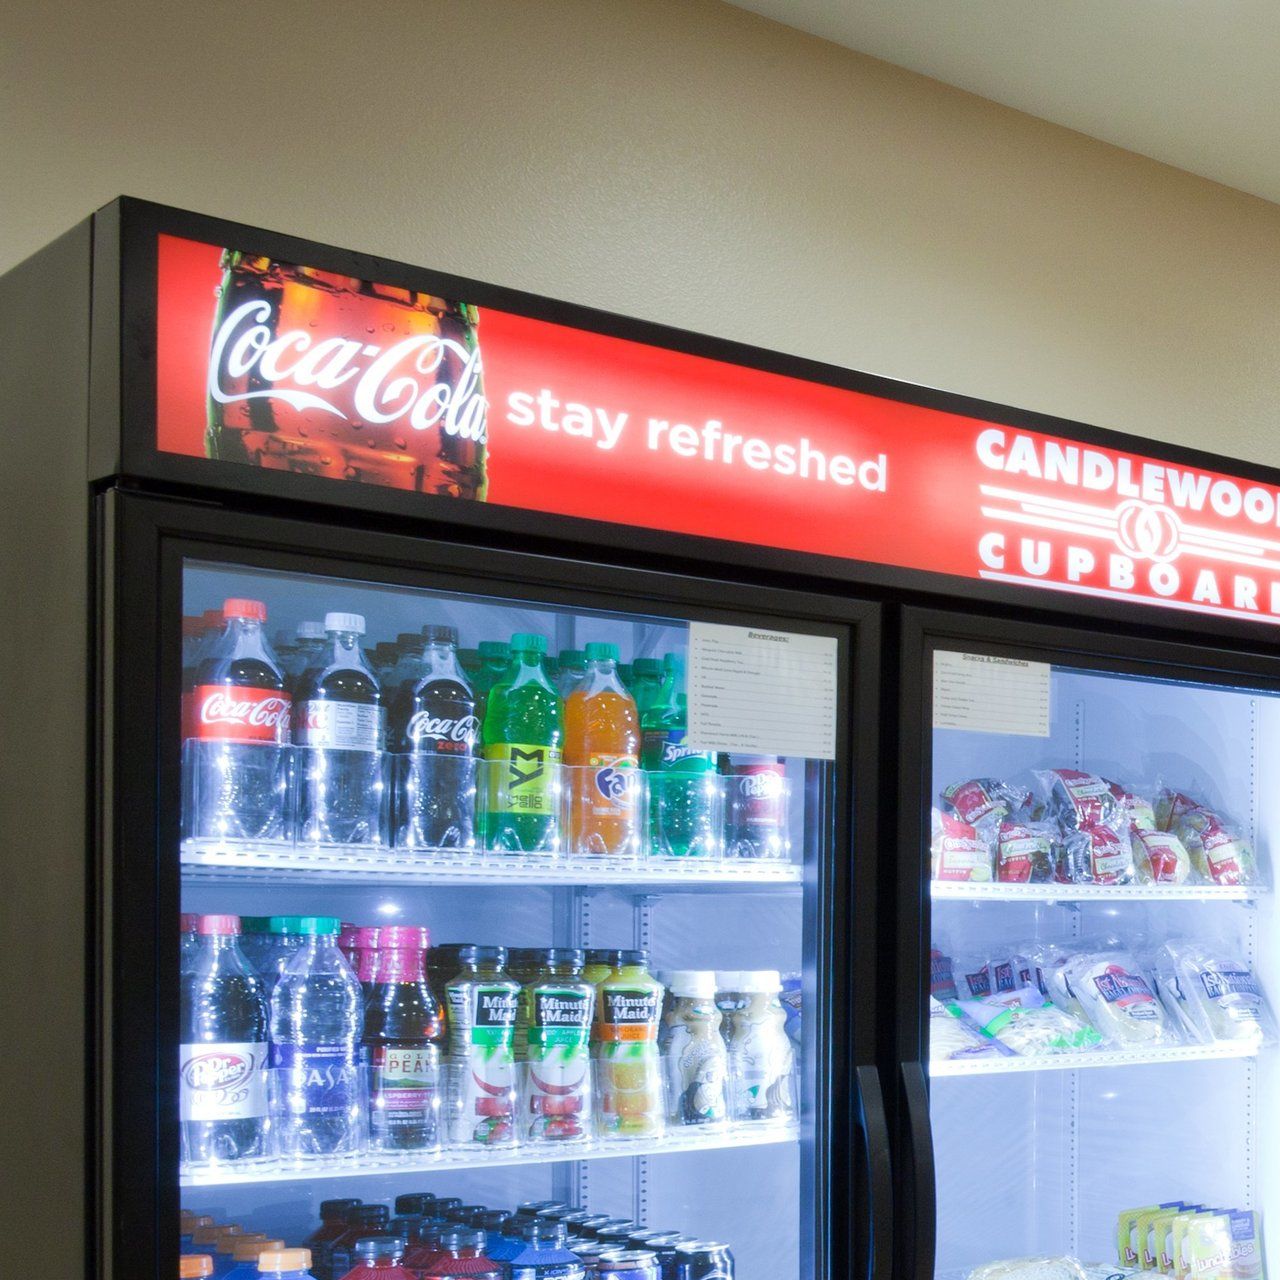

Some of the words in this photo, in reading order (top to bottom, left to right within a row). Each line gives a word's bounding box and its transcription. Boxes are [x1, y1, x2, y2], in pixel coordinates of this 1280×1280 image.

[207, 299, 488, 445] Coca-Cola
[507, 388, 628, 450] stay
[646, 418, 888, 493] refreshed
[545, 1009, 584, 1023] Maid
[614, 1007, 650, 1020] Maid
